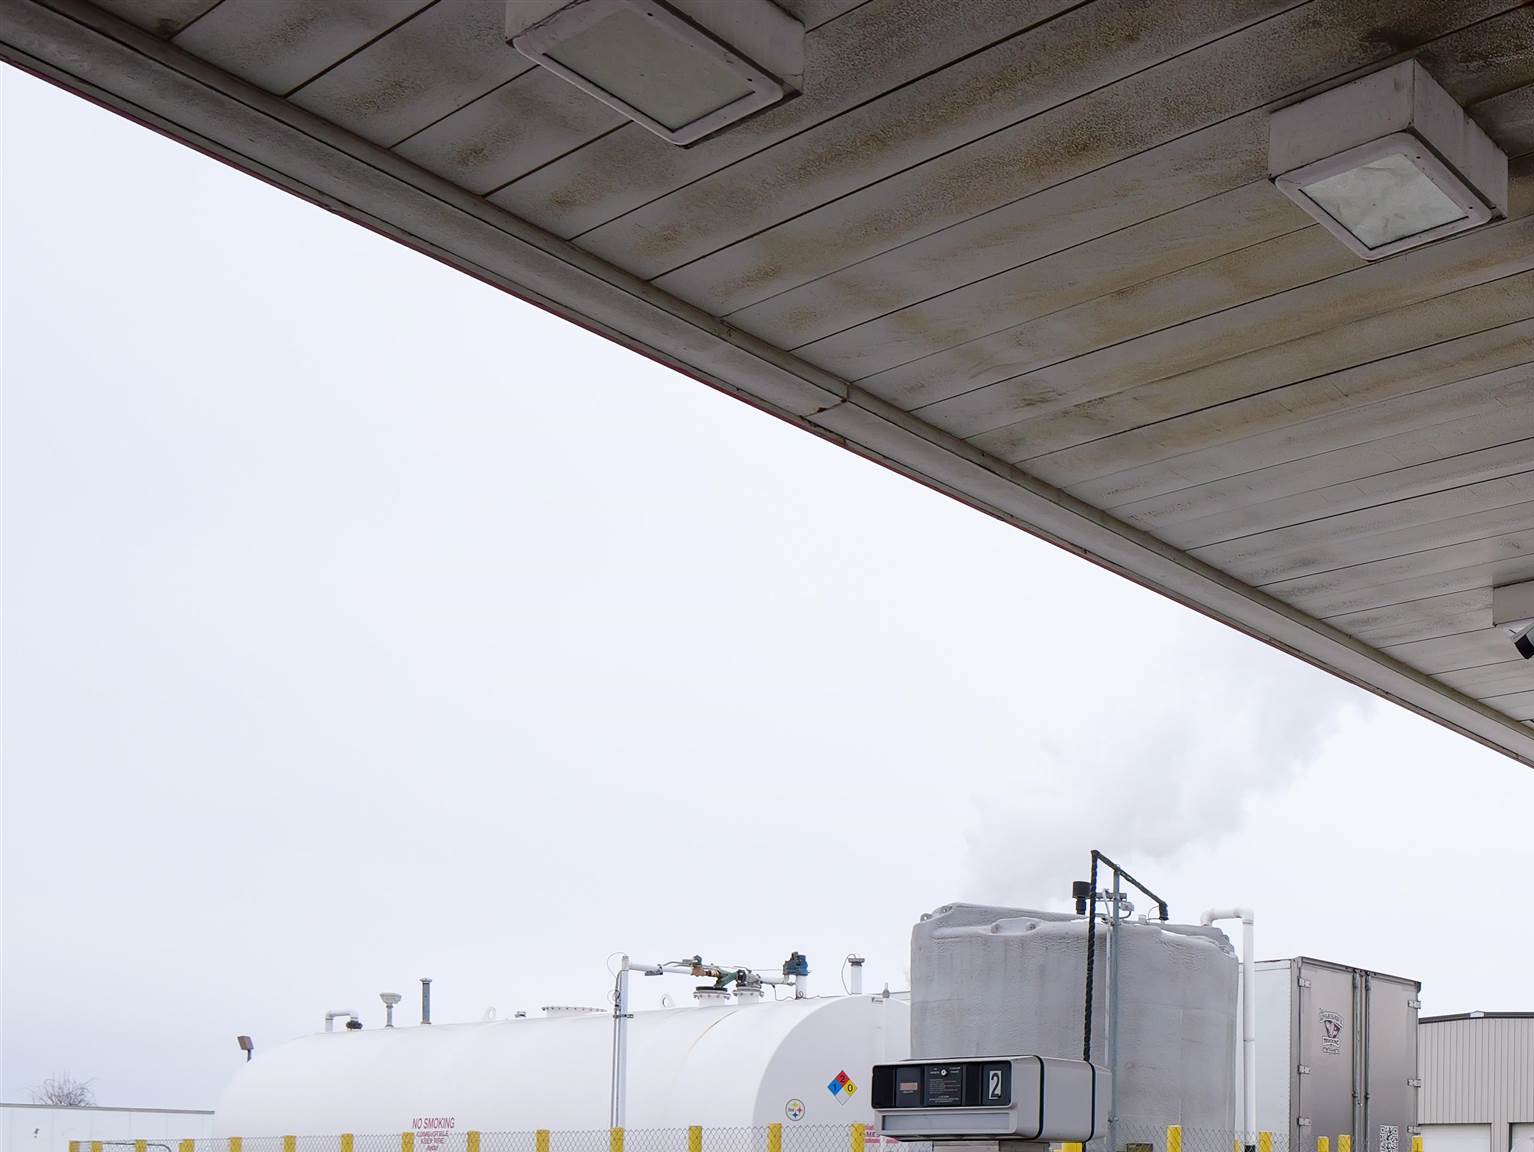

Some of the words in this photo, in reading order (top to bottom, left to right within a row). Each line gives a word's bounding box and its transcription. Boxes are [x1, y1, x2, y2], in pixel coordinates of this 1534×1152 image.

[840, 1075, 846, 1083] 2
[847, 1084, 853, 1092] 0
[990, 1072, 1001, 1099] 2
[412, 1118, 422, 1129] NO
[423, 1117, 455, 1129] SMOKING
